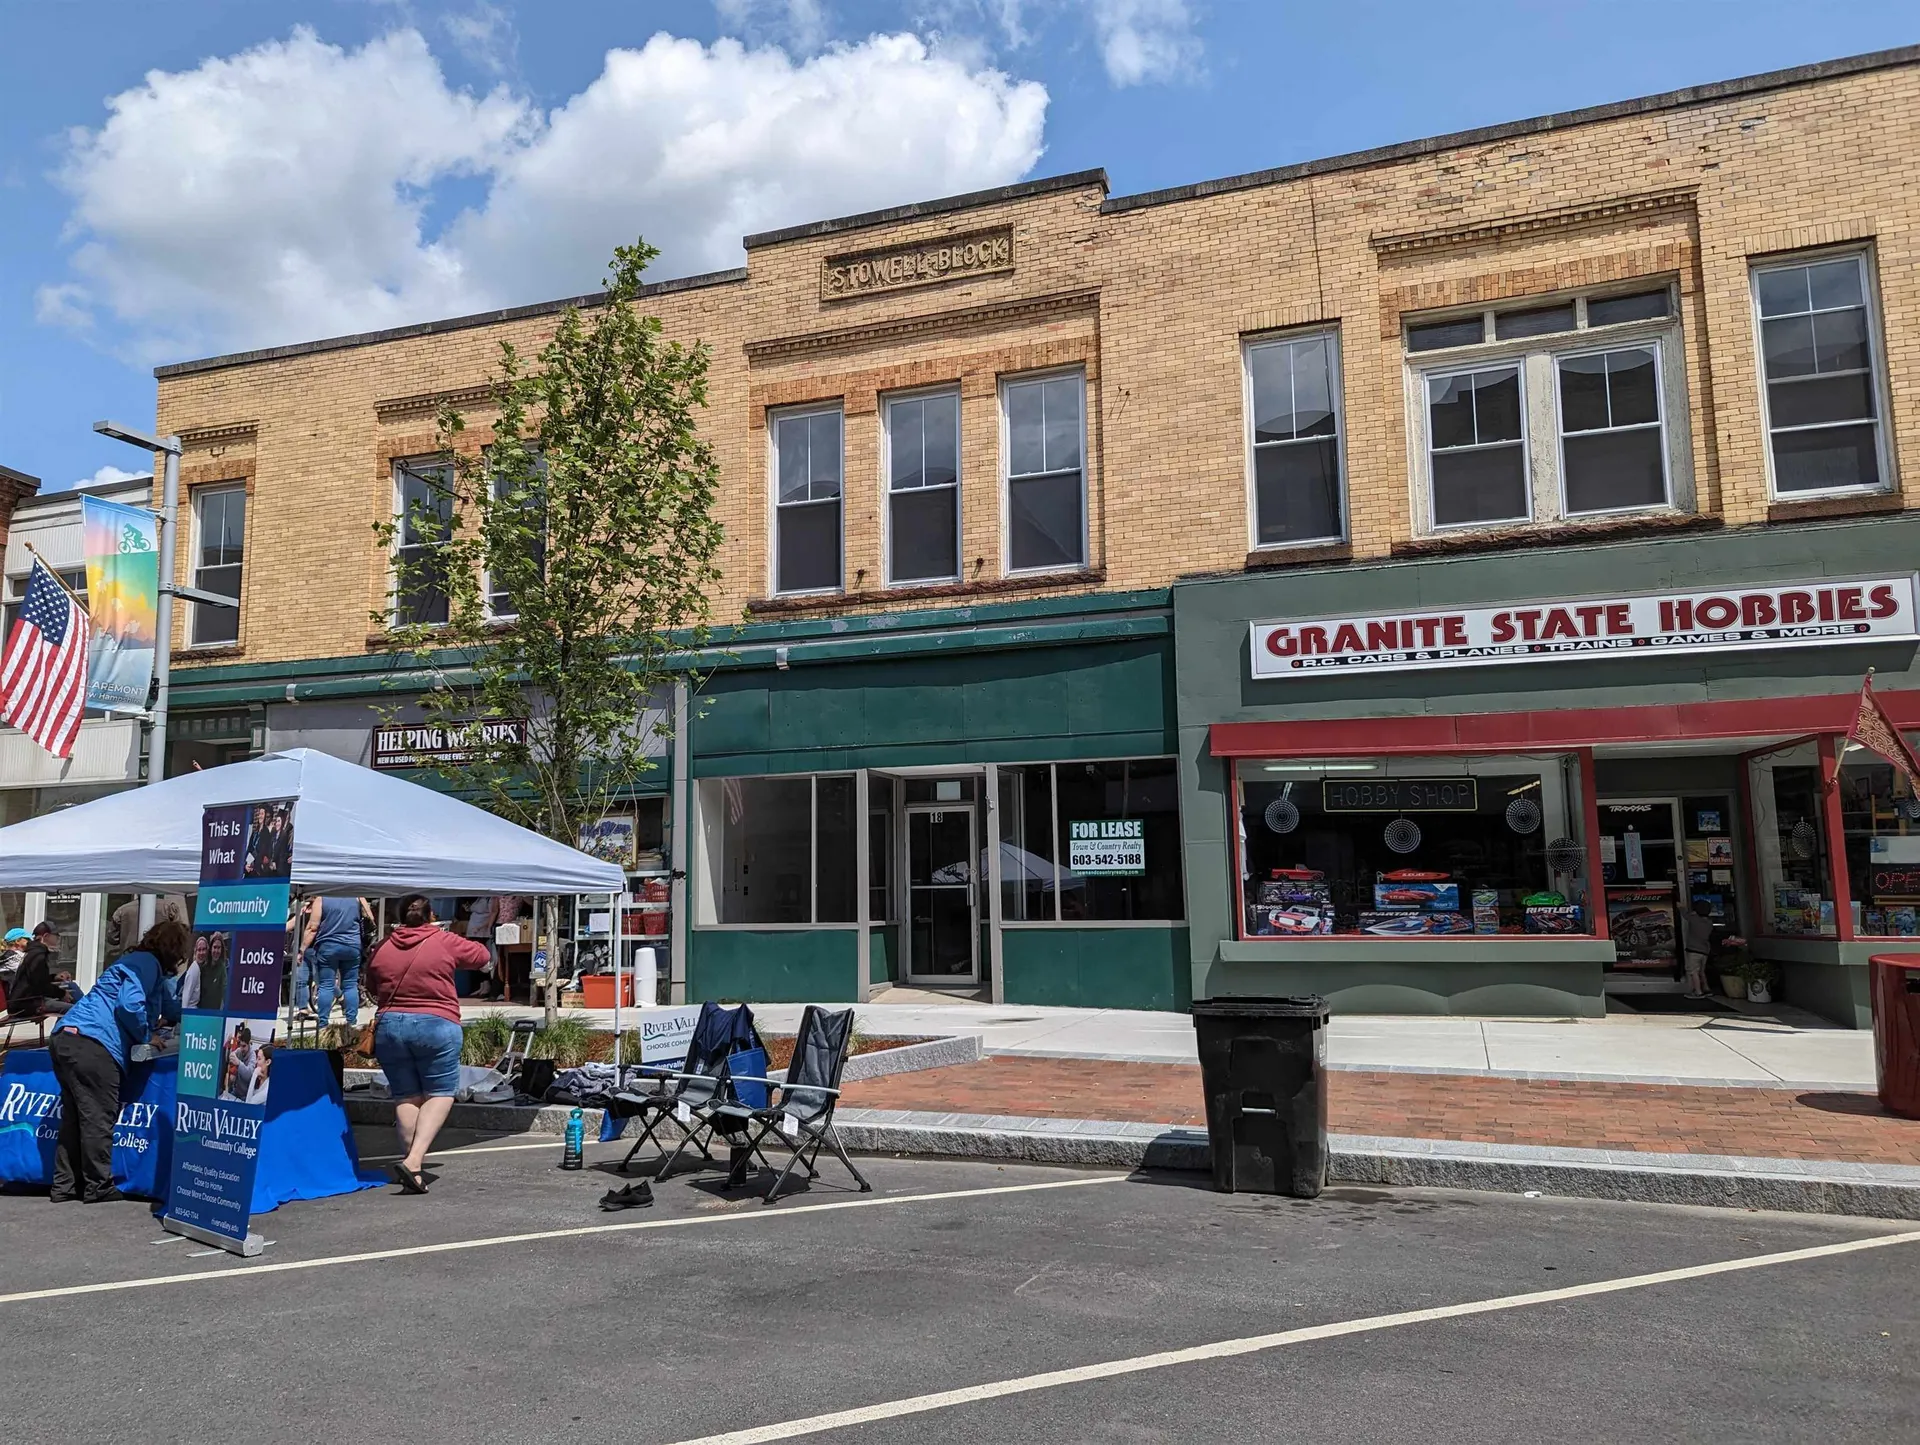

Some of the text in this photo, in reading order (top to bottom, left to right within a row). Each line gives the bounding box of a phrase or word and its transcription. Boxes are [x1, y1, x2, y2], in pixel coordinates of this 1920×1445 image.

[939, 238, 1008, 270] BLOCK
[1266, 584, 1899, 656] GRANITE STATE HOBBIES
[1303, 658, 1340, 667] R.C.
[1347, 653, 1407, 664] CARS
[1439, 645, 1529, 658] PLANES
[1545, 639, 1632, 651] TRAINS
[1650, 632, 1741, 645] GAMES
[1750, 630, 1769, 638] &
[1779, 625, 1855, 637] MORE
[87, 681, 144, 696] LAREMONT
[377, 724, 517, 751] HELPING WORIES
[1330, 784, 1469, 806] HOBBY SHOP
[932, 812, 943, 822] 18
[1609, 804, 1652, 812] TRAXXAS
[209, 821, 240, 837] This Is
[1072, 821, 1141, 838] FOR LEASE
[1072, 841, 1141, 852] Town & Country Realty
[209, 848, 235, 864] What
[1072, 854, 1141, 865] 603-542-5188
[208, 896, 270, 917] Community
[1525, 906, 1574, 914] RUSTLER
[240, 947, 274, 965] Looks
[241, 977, 264, 994] Like
[643, 1017, 696, 1036] RIVER VALL
[185, 1033, 217, 1051] This Is
[646, 1041, 670, 1051] CHOOSE
[184, 1062, 212, 1080] RVCC
[0, 1083, 64, 1121] RIVER
[176, 1102, 262, 1139] RIVER VALLEY
[201, 1135, 257, 1160] Community College
[193, 1177, 204, 1187] Close
[203, 1167, 218, 1179] Quality
[218, 1170, 240, 1182] Education
[176, 1185, 241, 1212] Choose More Choose Community
